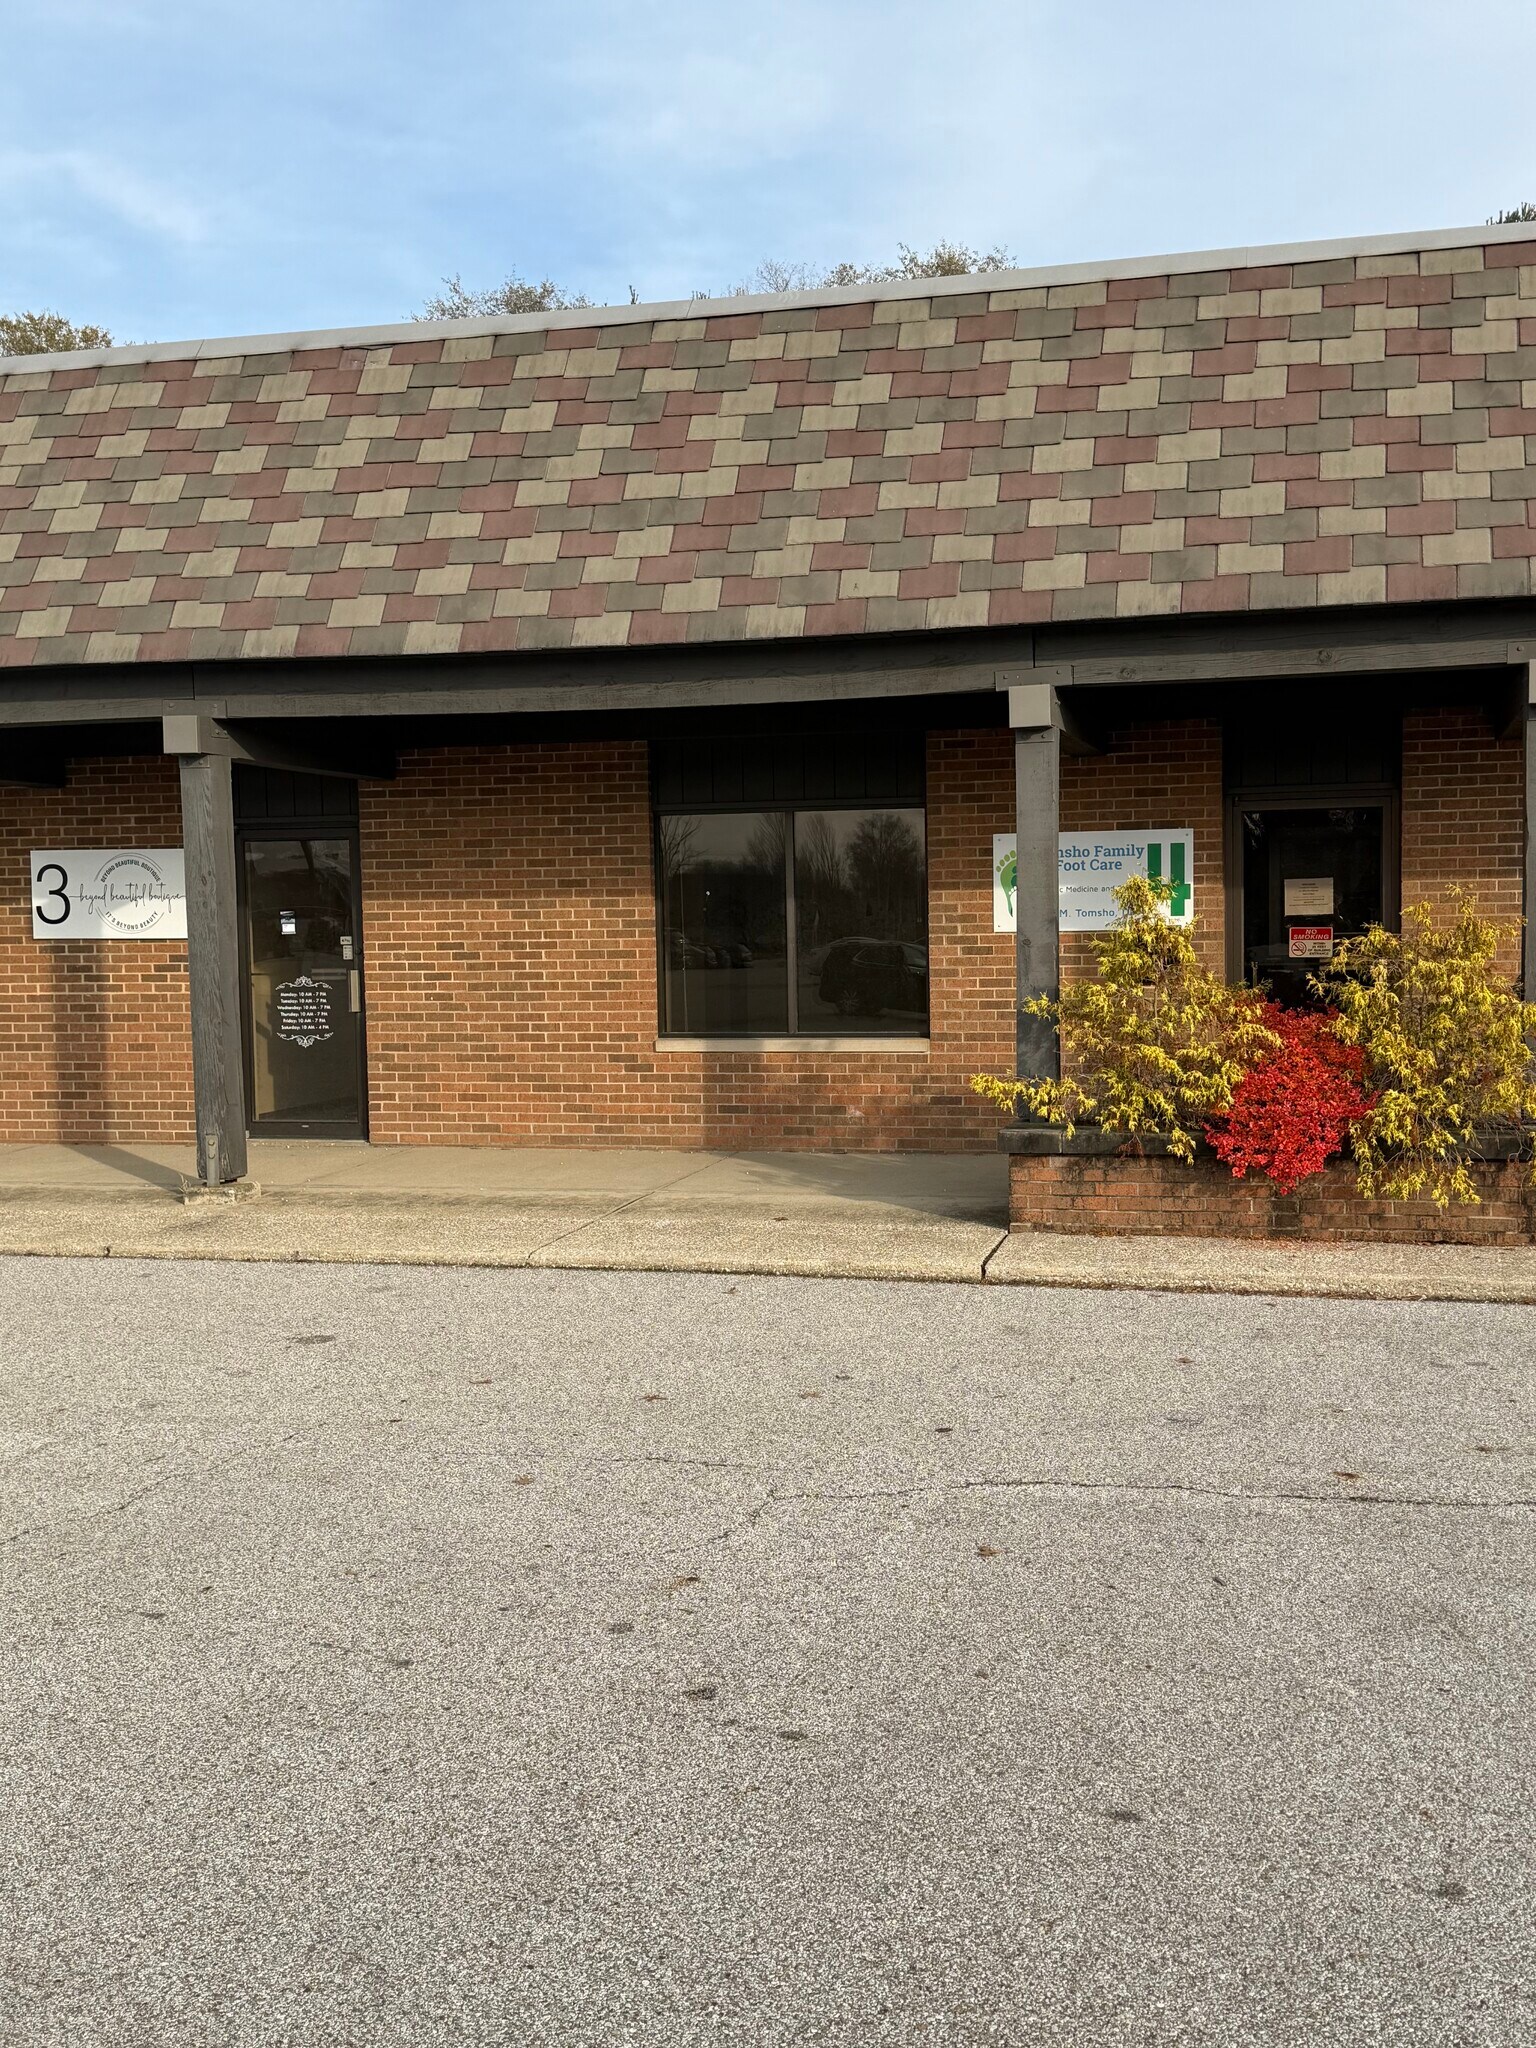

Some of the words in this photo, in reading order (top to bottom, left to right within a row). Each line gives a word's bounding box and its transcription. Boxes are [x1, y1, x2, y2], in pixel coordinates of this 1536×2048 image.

[1094, 845, 1144, 859] Family
[100, 865, 115, 882] BEYOND
[114, 860, 140, 868] BEAUTIFUL
[141, 862, 161, 882] BOUTIQUE
[1090, 859, 1122, 870] Care
[36, 864, 70, 924] 3
[79, 884, 106, 914] beyond
[110, 882, 146, 907] beautiful
[149, 882, 185, 913] boutique
[106, 911, 116, 922] IT'S
[116, 921, 138, 930] BEYOND
[140, 911, 158, 928] BEAUTY
[1076, 909, 1117, 917] Tomsho,
